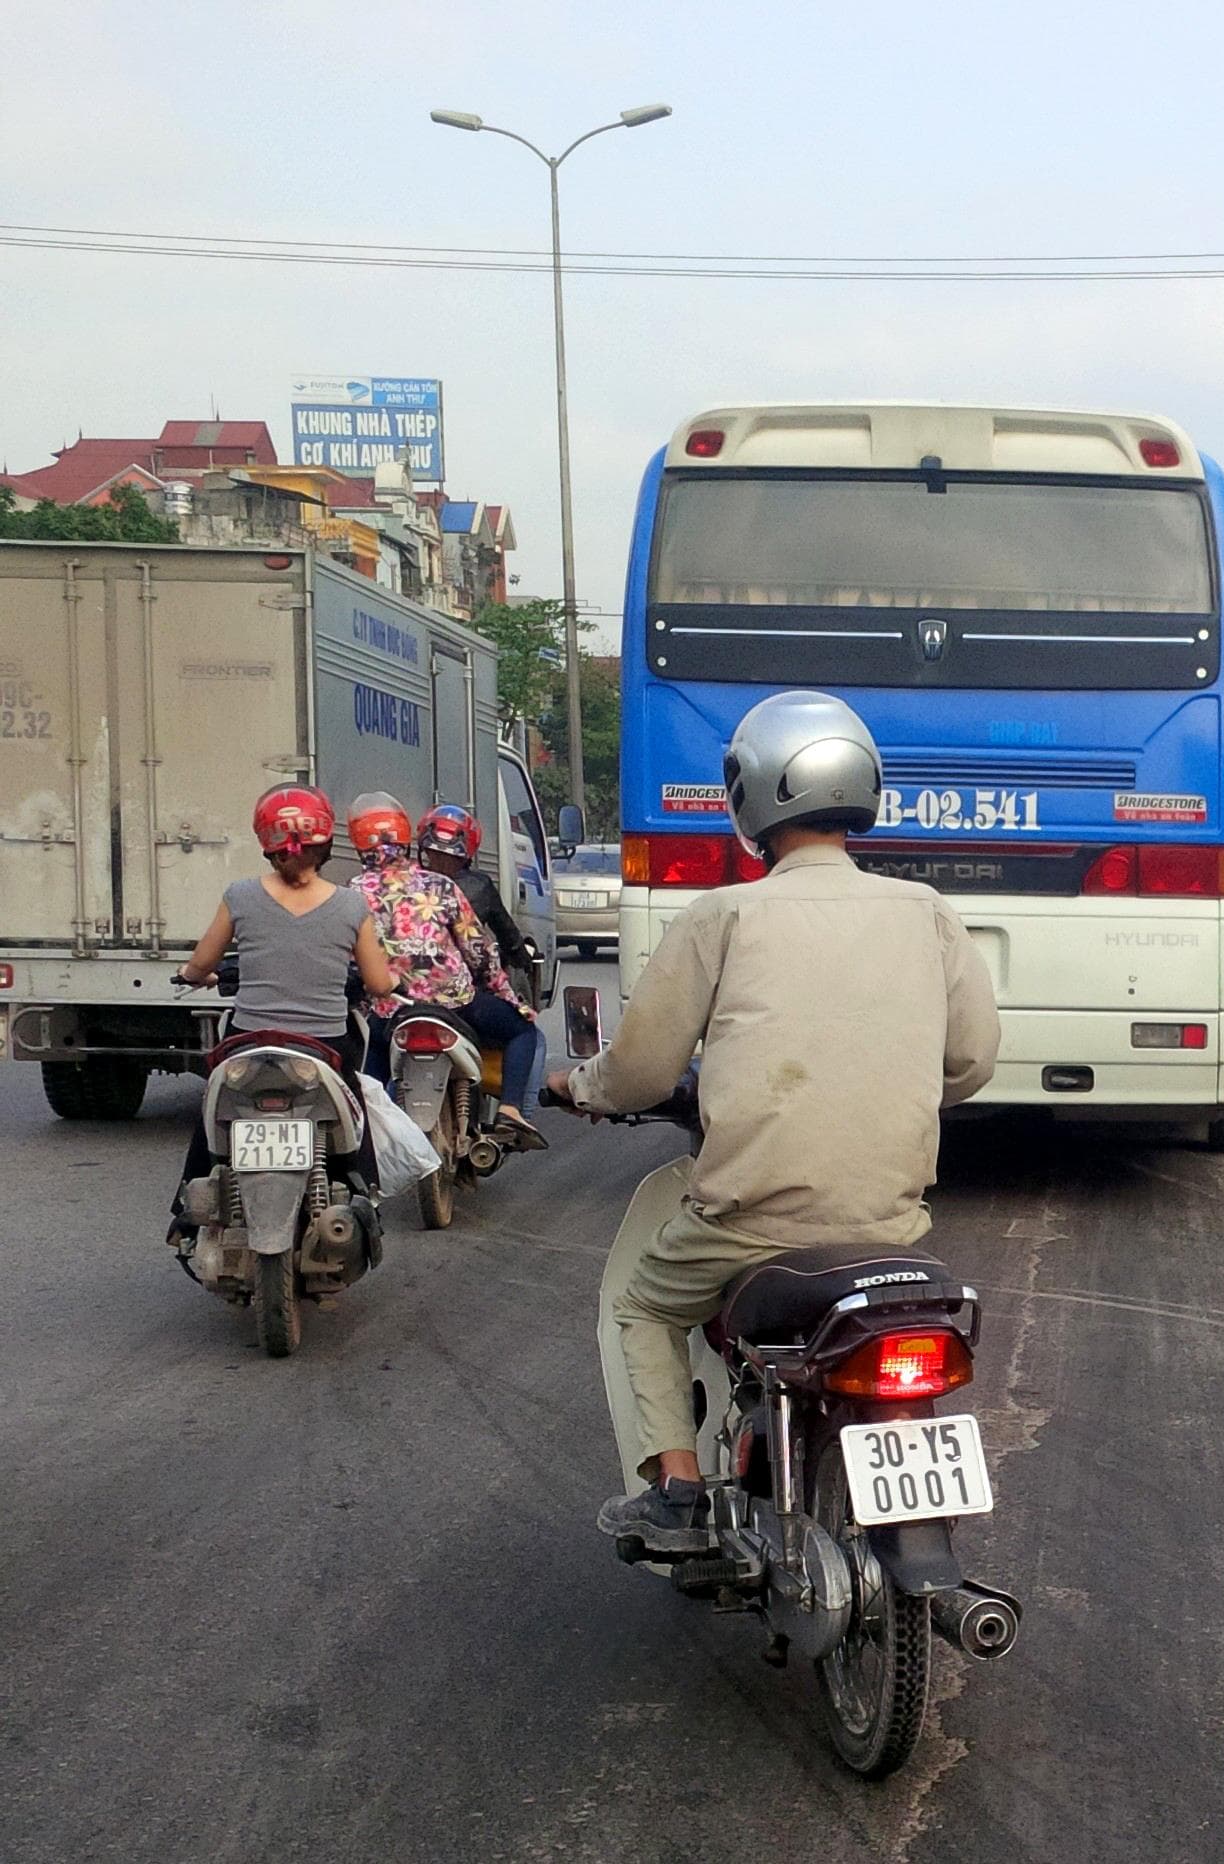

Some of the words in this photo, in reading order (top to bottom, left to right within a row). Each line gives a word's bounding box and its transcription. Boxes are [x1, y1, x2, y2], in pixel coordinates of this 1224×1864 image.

[297, 411, 352, 436] KHUNG
[356, 409, 391, 436] NHÀ
[395, 409, 437, 438] THÉP
[301, 441, 323, 466] CƠ
[330, 438, 357, 467] KHÍ
[361, 444, 394, 467] ANH
[182, 664, 272, 677] FRONTIER
[1, 711, 53, 738] 2.32
[354, 683, 397, 742] QUANG
[400, 699, 420, 748] GIA
[664, 786, 725, 799] BRIDGEST
[1117, 795, 1205, 810] BRIDGESTONE
[874, 789, 1042, 831] B-02.541
[1104, 931, 1200, 947] HYUNDAI
[244, 1123, 300, 1144] 29-N1
[238, 1146, 307, 1168] 211.25
[854, 1271, 930, 1289] HONDA
[864, 1423, 962, 1470] 30-Y5
[872, 1467, 969, 1514] 0001
